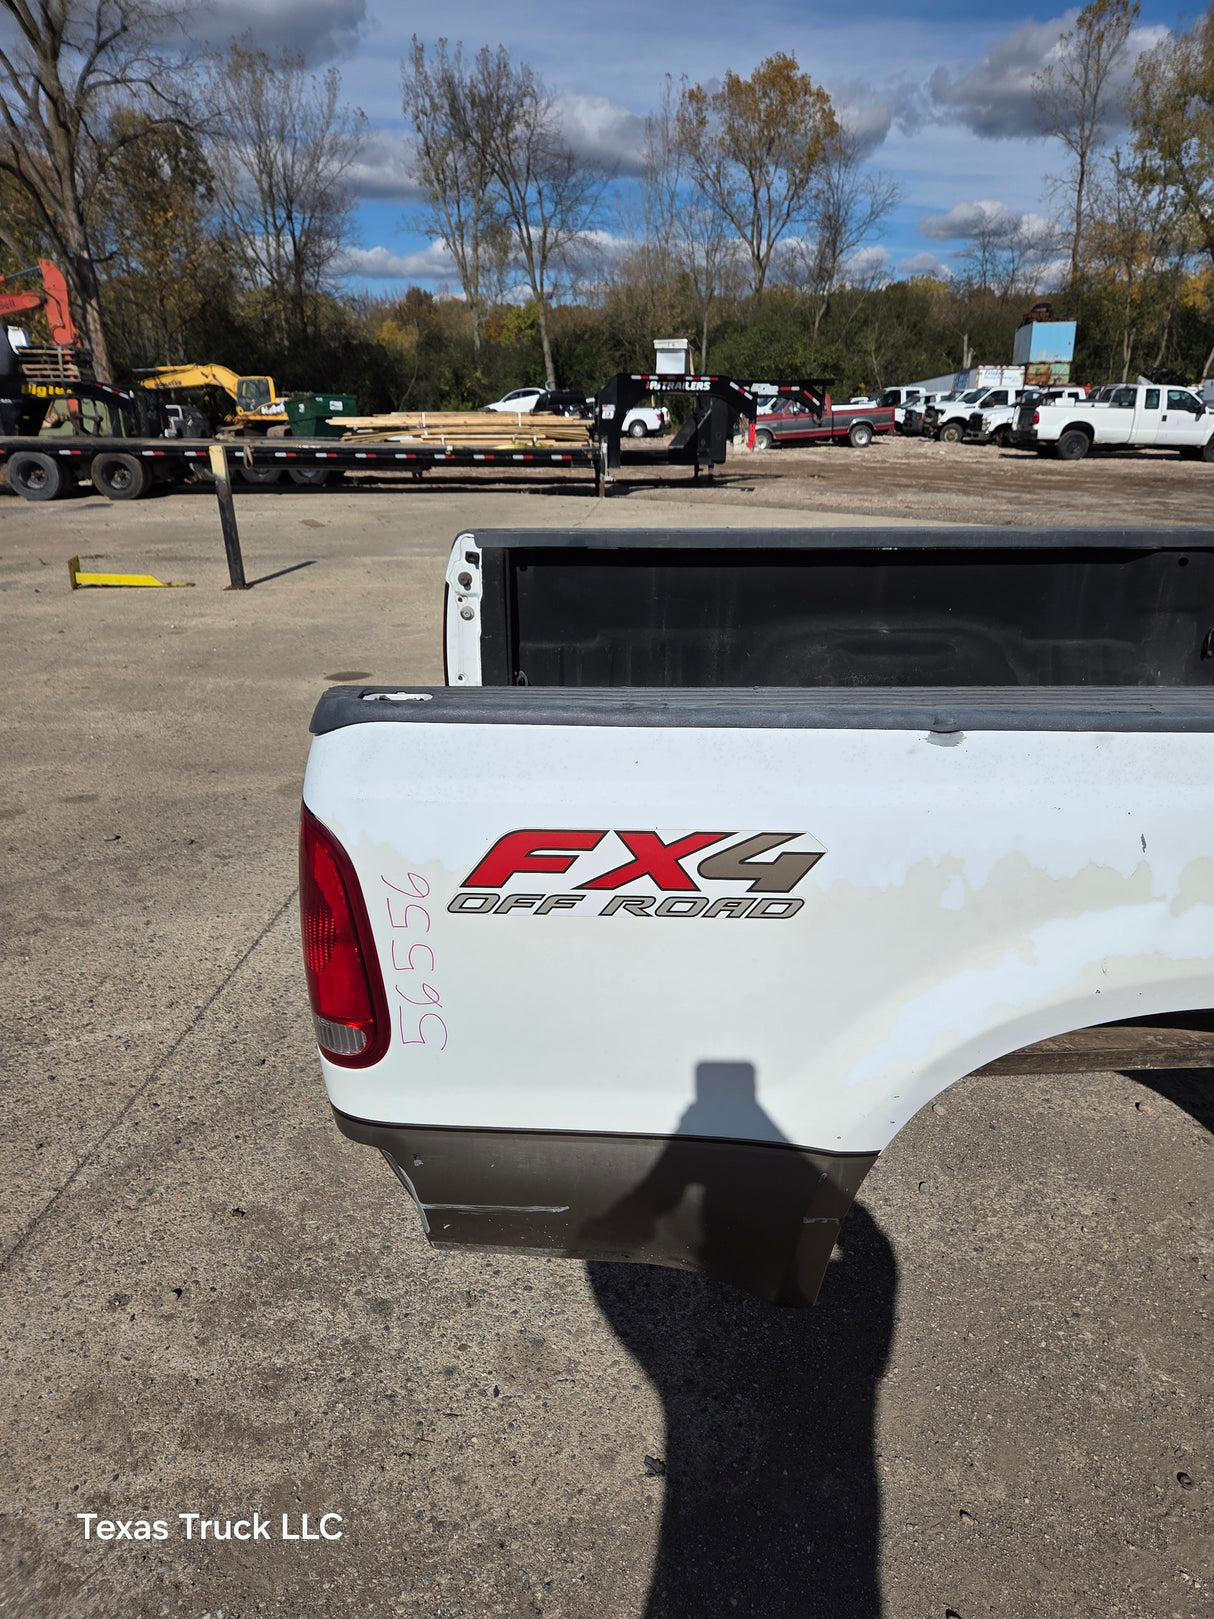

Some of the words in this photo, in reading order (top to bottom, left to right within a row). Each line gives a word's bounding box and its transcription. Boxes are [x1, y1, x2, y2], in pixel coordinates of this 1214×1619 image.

[460, 829, 826, 893] FX4
[446, 893, 586, 915] OFF
[598, 895, 806, 919] ROAD
[381, 872, 448, 1050] 56556
